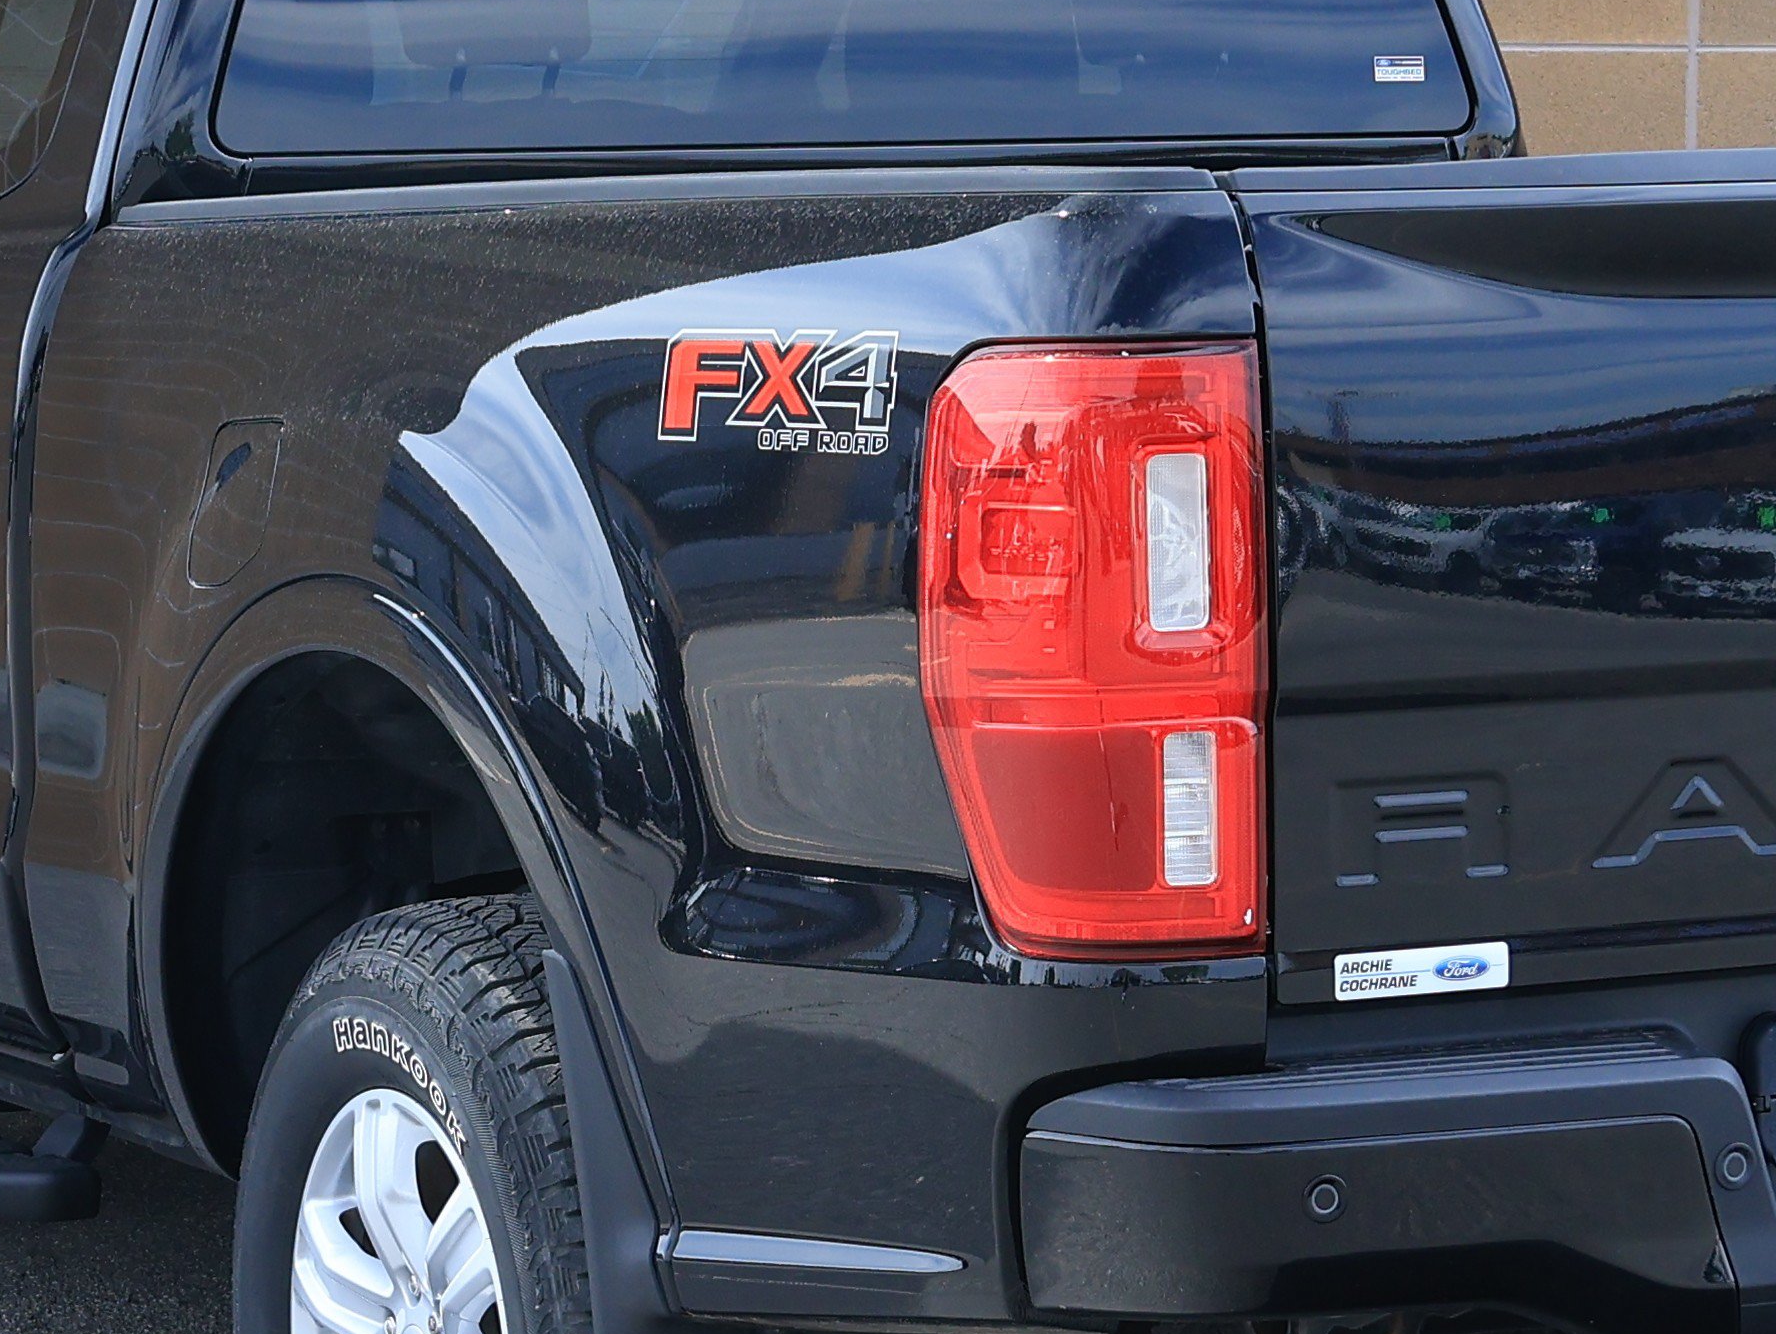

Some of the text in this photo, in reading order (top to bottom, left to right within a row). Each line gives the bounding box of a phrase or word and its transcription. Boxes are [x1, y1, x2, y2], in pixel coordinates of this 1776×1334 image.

[658, 328, 899, 441] FX4
[758, 429, 889, 454] OFF ROAD
[1339, 958, 1393, 975] ARCHIE
[1442, 960, 1479, 978] Ford
[1339, 974, 1418, 993] COCHRANE
